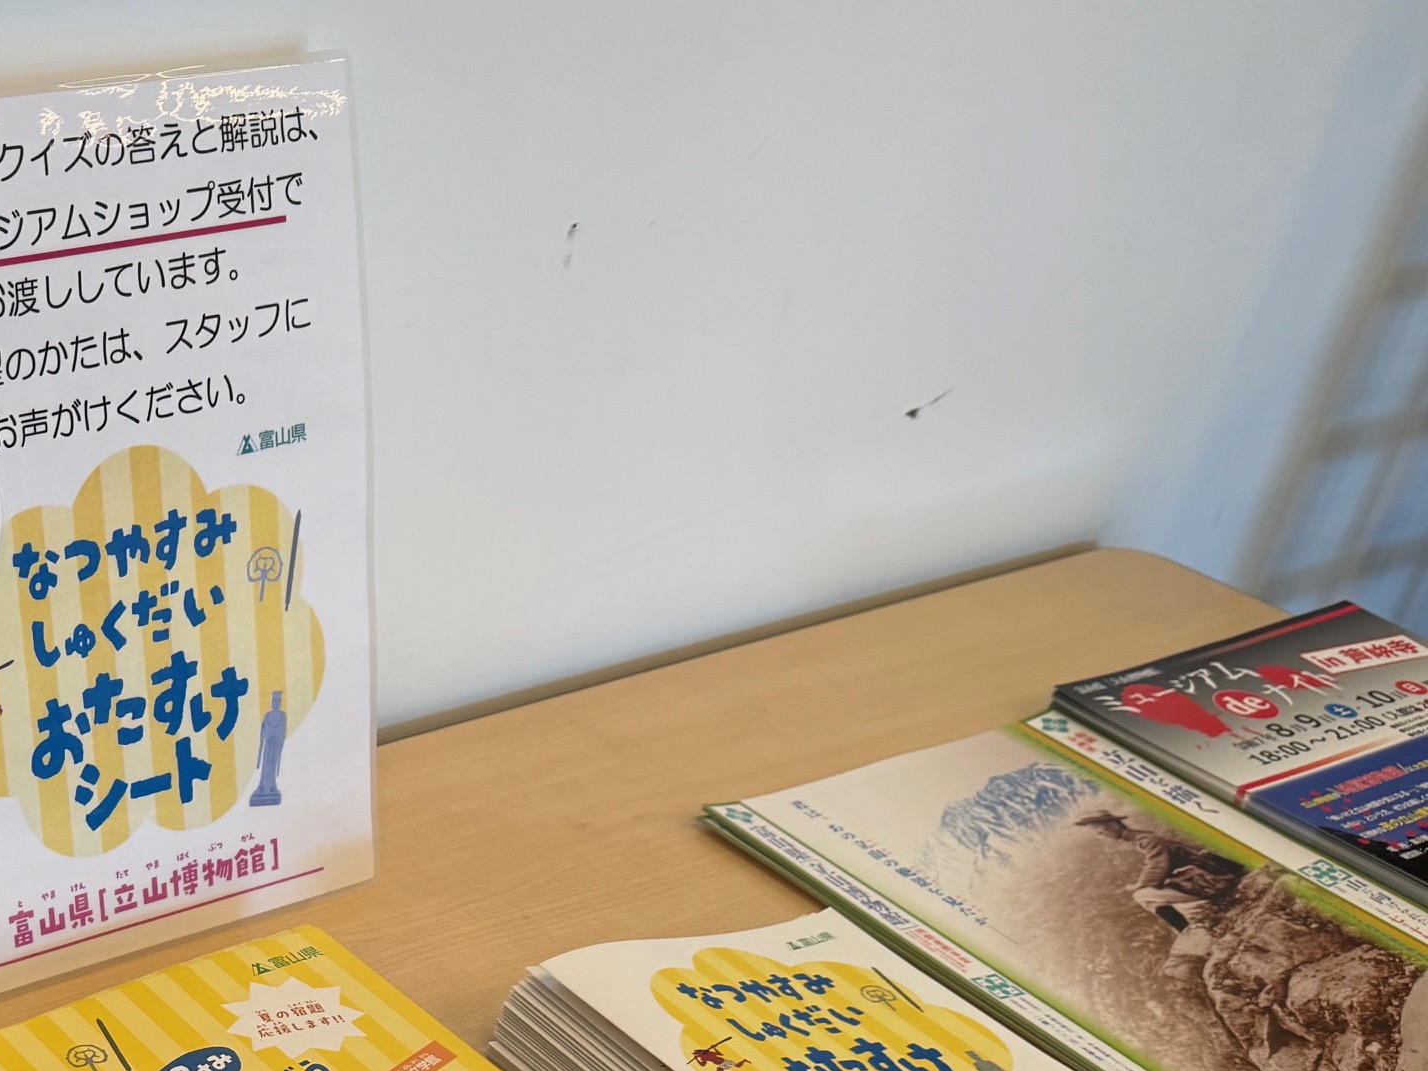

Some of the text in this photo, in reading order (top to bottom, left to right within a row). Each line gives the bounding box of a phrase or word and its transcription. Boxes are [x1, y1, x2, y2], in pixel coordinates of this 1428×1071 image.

[258, 423, 308, 452] 富山県
[12, 508, 238, 602] なつやすみ
[30, 581, 226, 671] しゅくだい
[30, 651, 249, 783] おたすけ
[75, 735, 215, 832] シート
[9, 838, 279, 948] 富山県[立山博物館]
[268, 945, 324, 970] 富山県
[798, 931, 837, 948] 富山県
[676, 973, 837, 1010] なつやすみ
[257, 1014, 345, 1039] 応援します!!
[258, 1002, 326, 1023] 夏の宿題
[726, 1005, 865, 1042] しゅくだい
